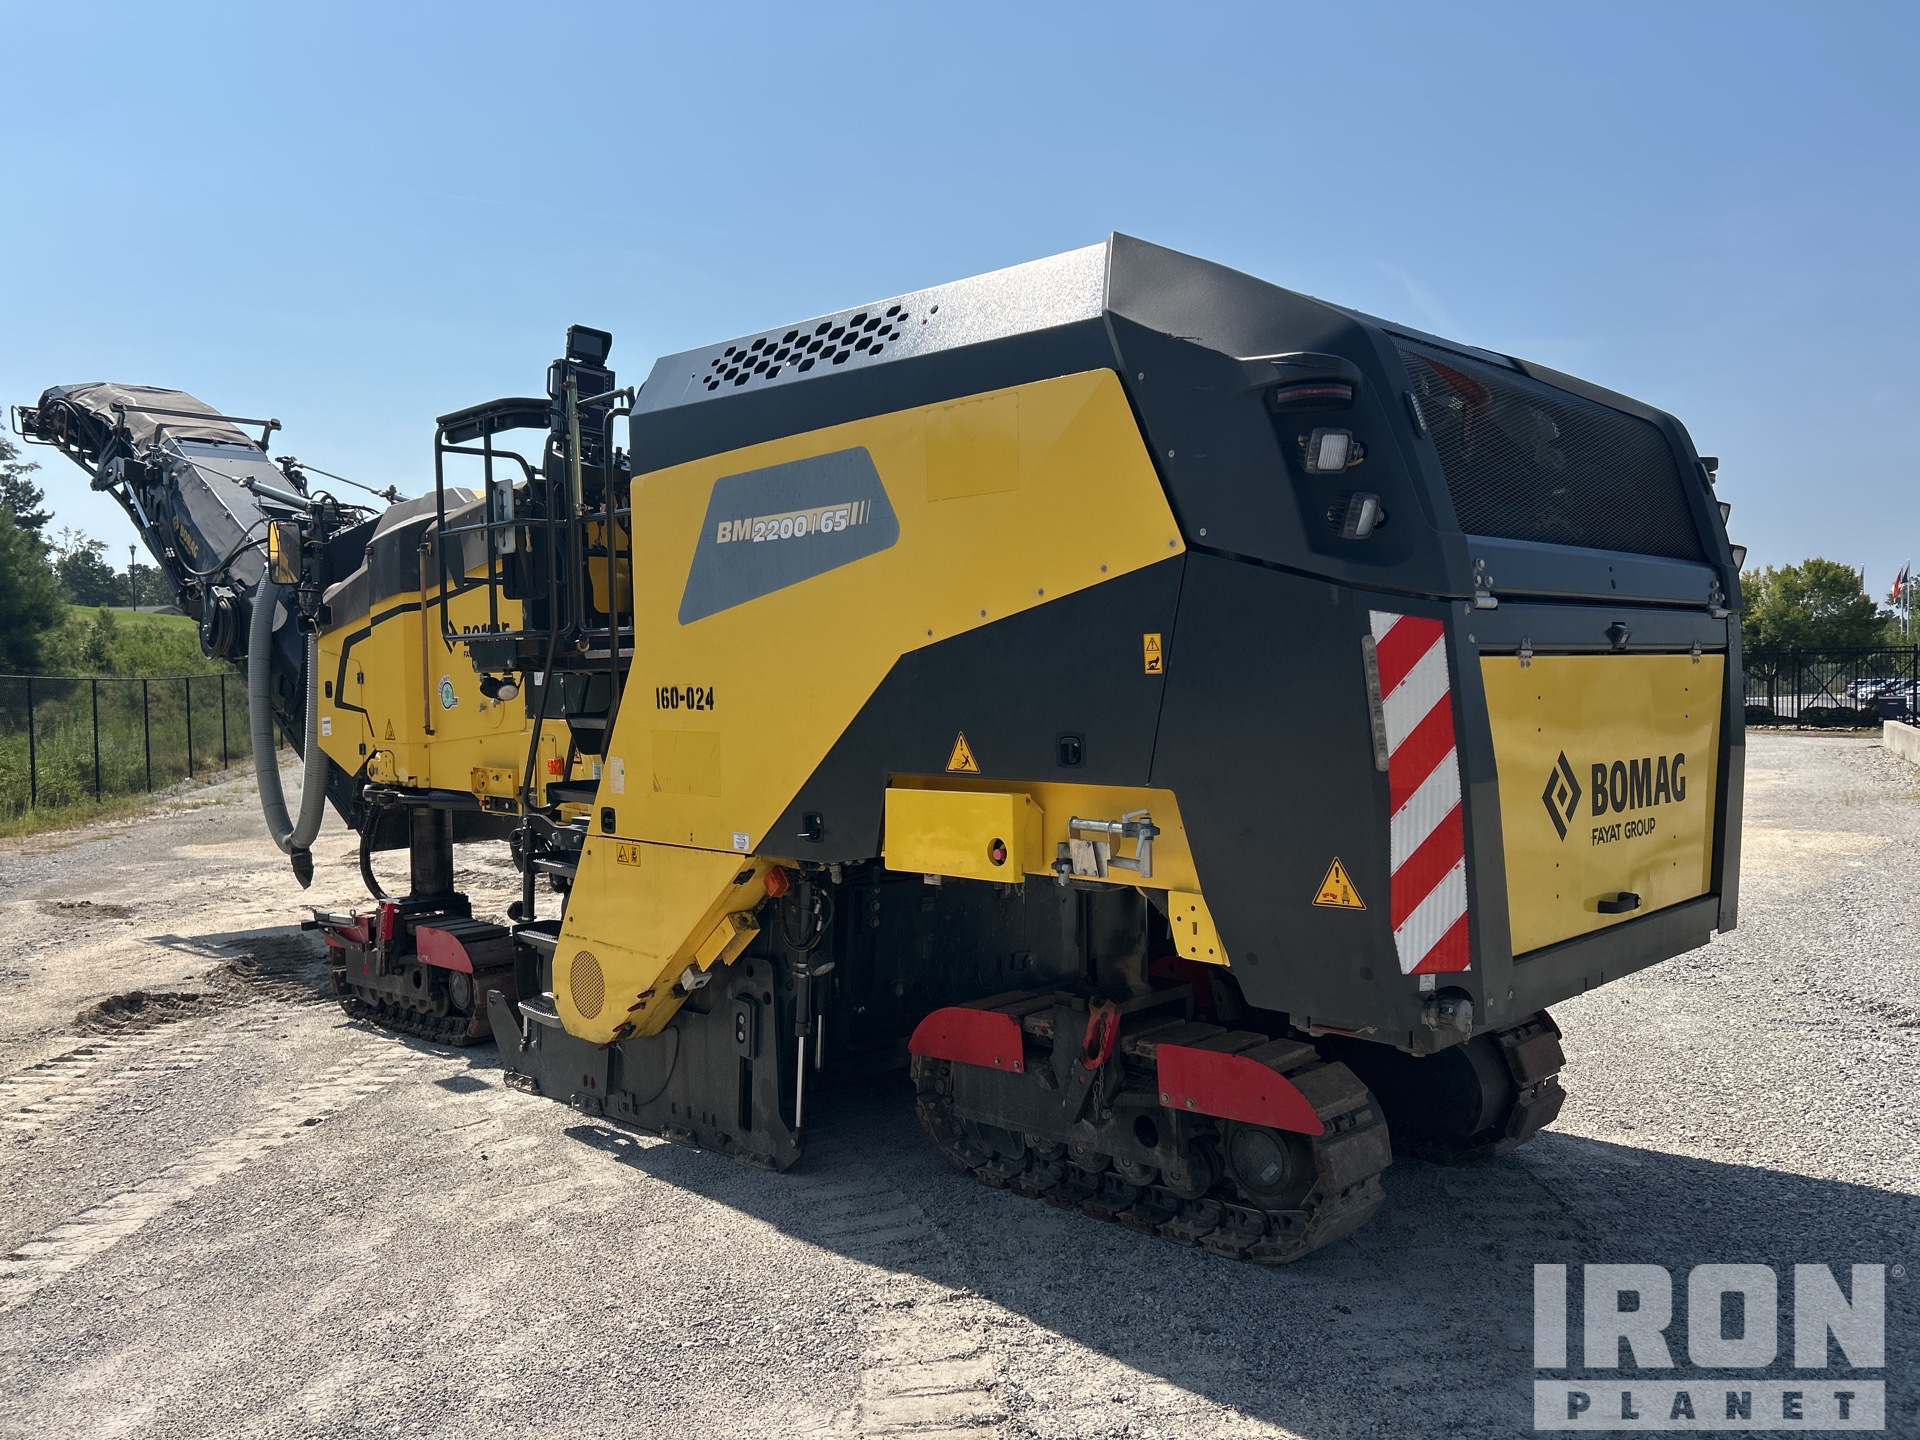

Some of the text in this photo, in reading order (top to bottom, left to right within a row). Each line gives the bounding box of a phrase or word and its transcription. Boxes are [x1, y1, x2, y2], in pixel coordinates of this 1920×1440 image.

[655, 686, 714, 710] 160-024
[1591, 752, 1686, 817] BOMAG
[1591, 817, 1656, 846] FAYAT GROUP
